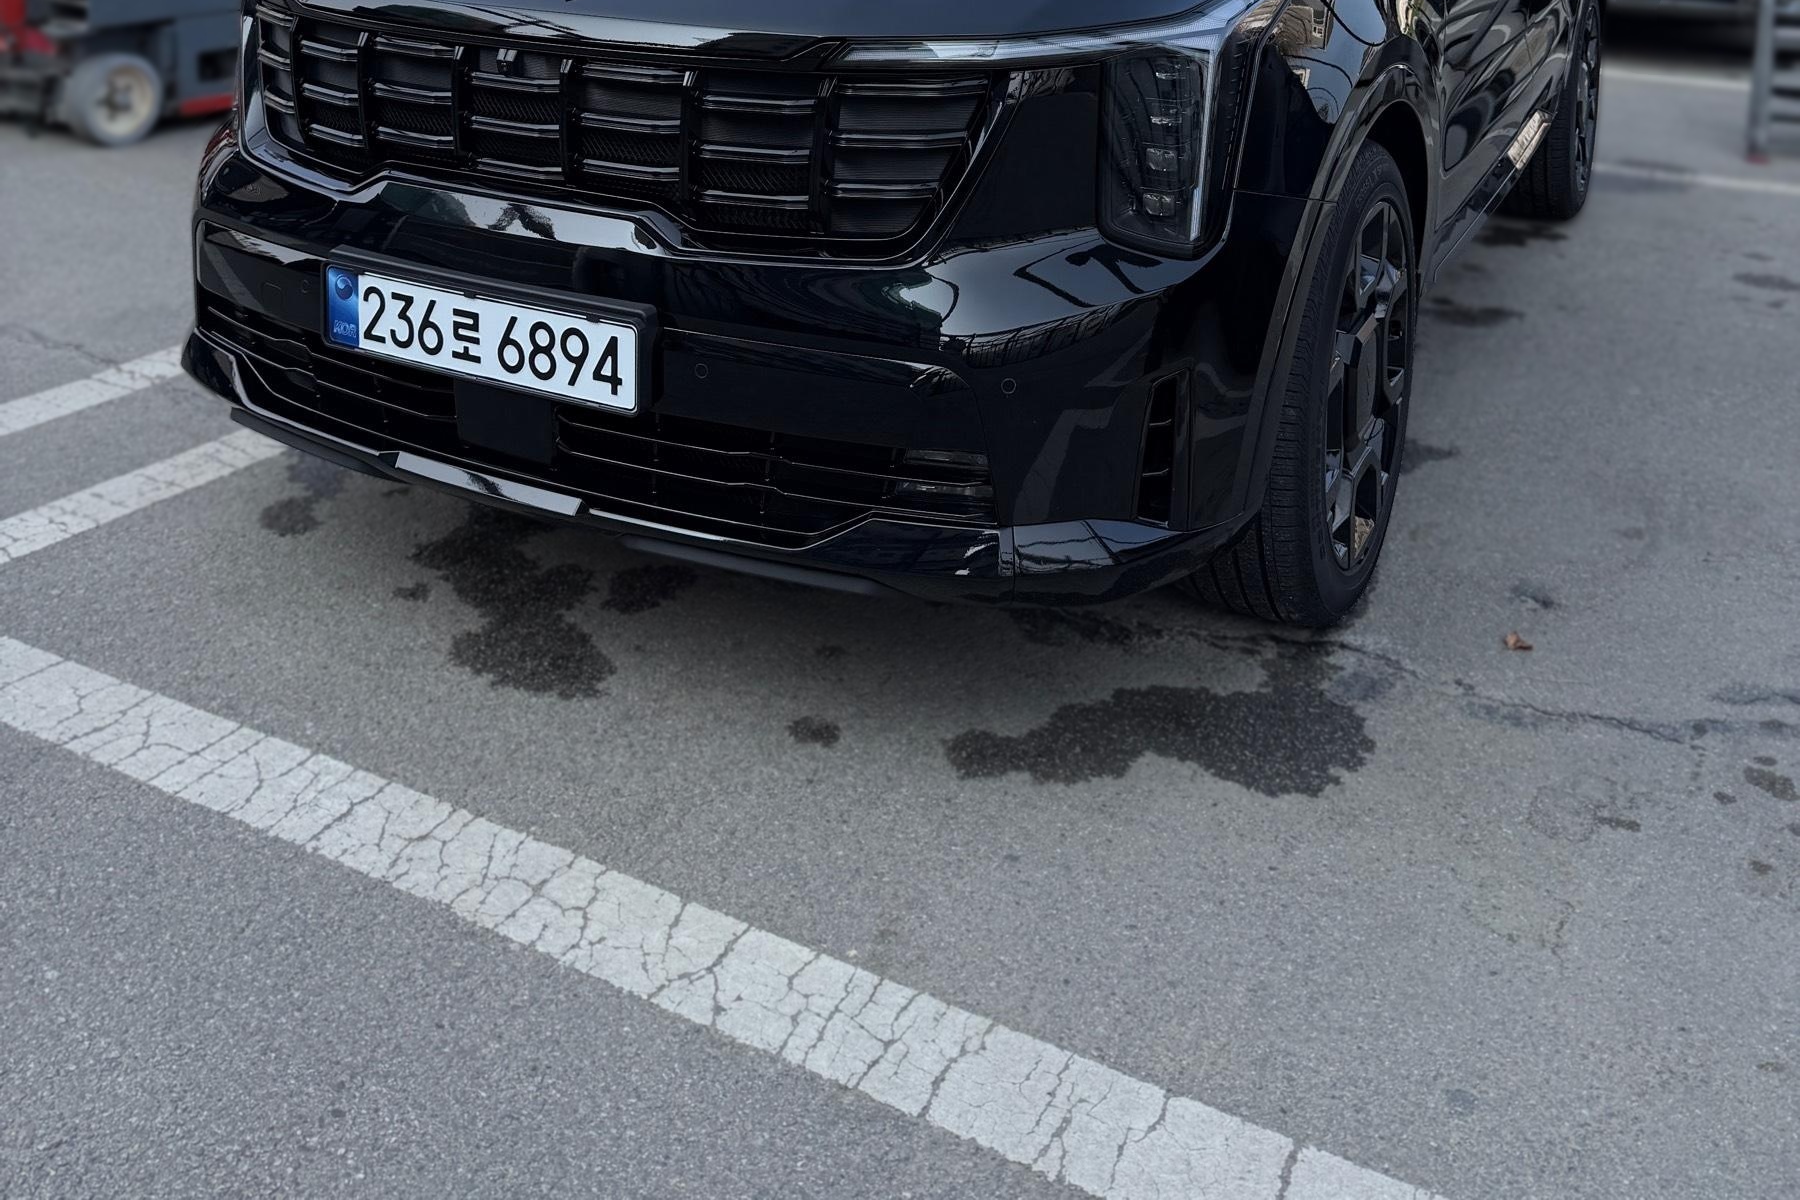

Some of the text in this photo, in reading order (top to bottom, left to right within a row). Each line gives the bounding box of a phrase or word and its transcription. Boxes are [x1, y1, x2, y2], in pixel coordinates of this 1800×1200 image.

[333, 319, 357, 338] KOR
[363, 286, 623, 396] 236로 6894
